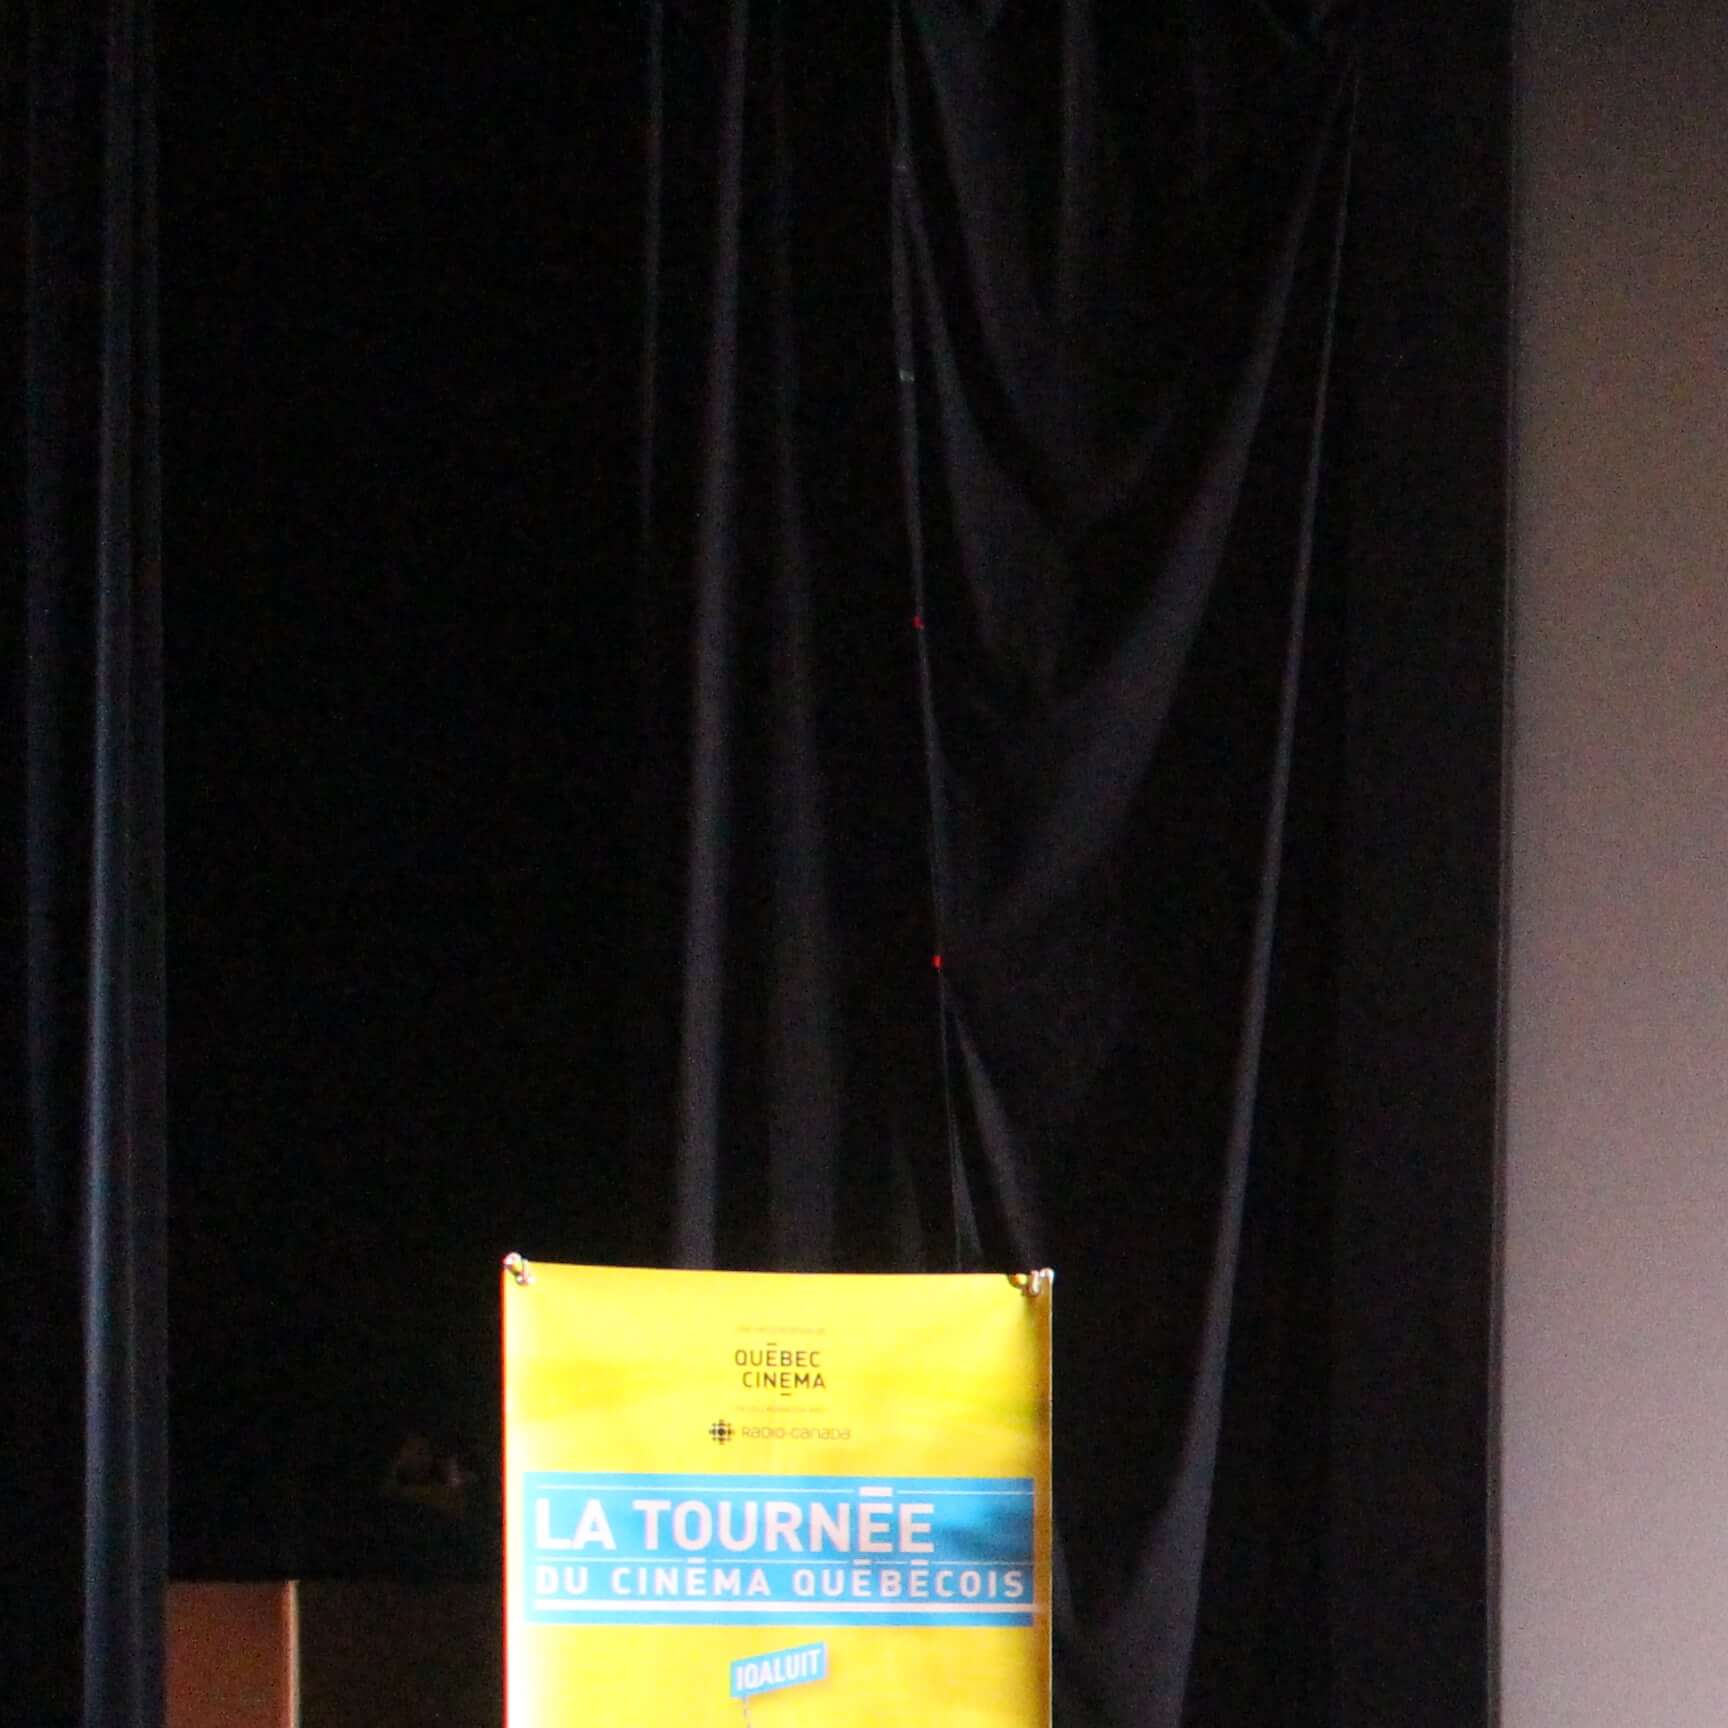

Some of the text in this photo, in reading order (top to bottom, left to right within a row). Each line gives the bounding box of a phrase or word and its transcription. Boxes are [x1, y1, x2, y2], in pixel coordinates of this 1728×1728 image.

[536, 1486, 935, 1554] LA TOURNÉE
[536, 1557, 1025, 1599] DU CINÉMA QUÉBÉCOIS
[735, 1647, 821, 1692] IQALUIT
